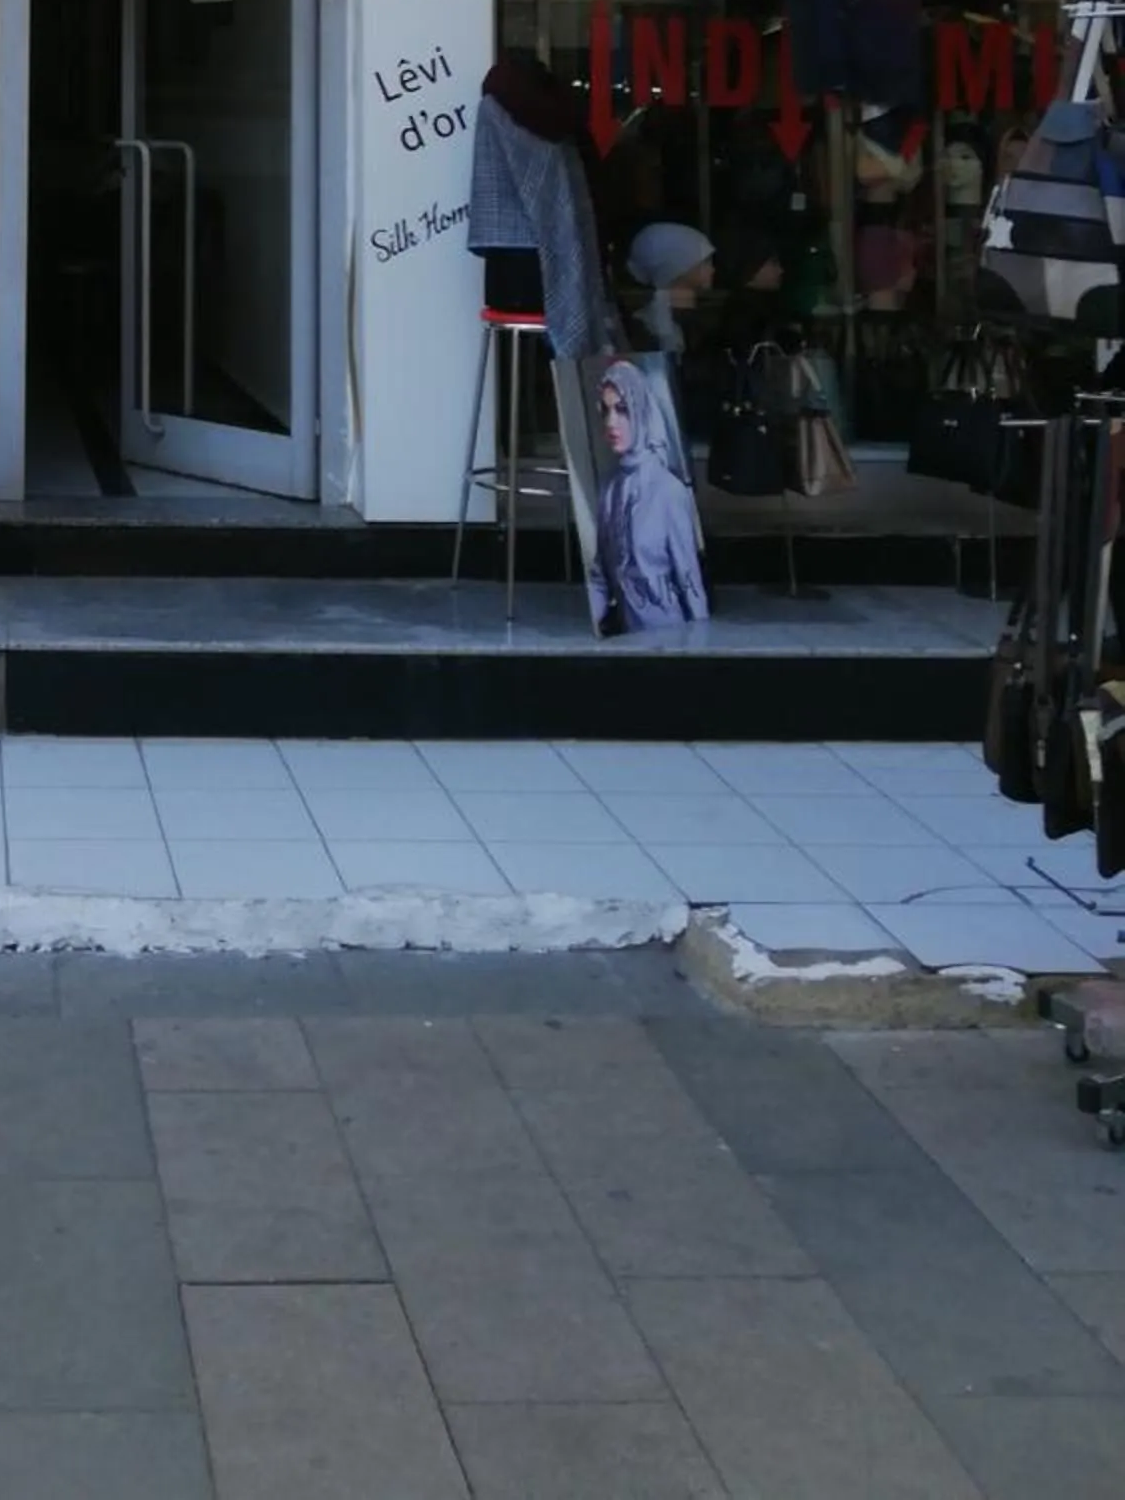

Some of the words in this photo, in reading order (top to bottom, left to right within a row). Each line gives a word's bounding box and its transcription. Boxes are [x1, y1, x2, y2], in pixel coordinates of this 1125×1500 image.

[375, 46, 452, 103] Lêvi
[399, 103, 468, 152] d'or
[370, 218, 420, 263] Silk
[418, 200, 472, 241] Hom
